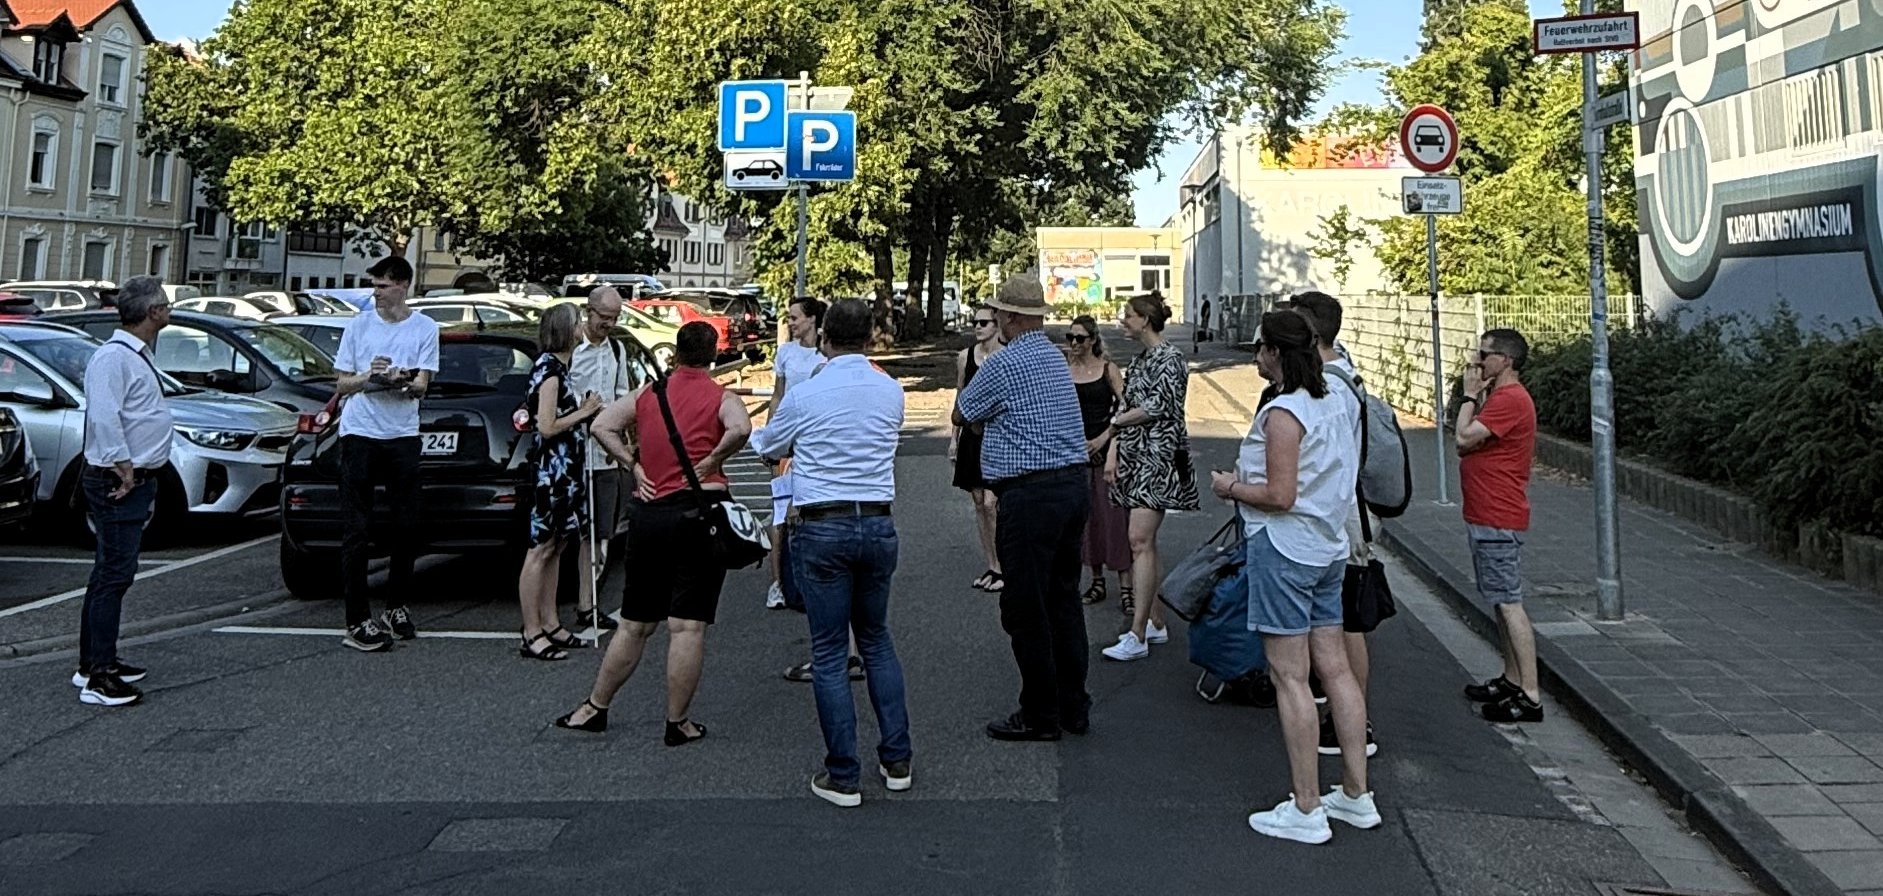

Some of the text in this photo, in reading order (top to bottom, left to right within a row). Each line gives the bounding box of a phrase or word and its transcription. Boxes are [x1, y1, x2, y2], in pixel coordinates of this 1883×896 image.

[1544, 21, 1628, 36] Feuerwehrzufahrt
[735, 90, 771, 142] P
[802, 119, 839, 171] P
[1726, 203, 1853, 244] KAROLINENGYMNASIUM
[427, 434, 455, 450] 241
